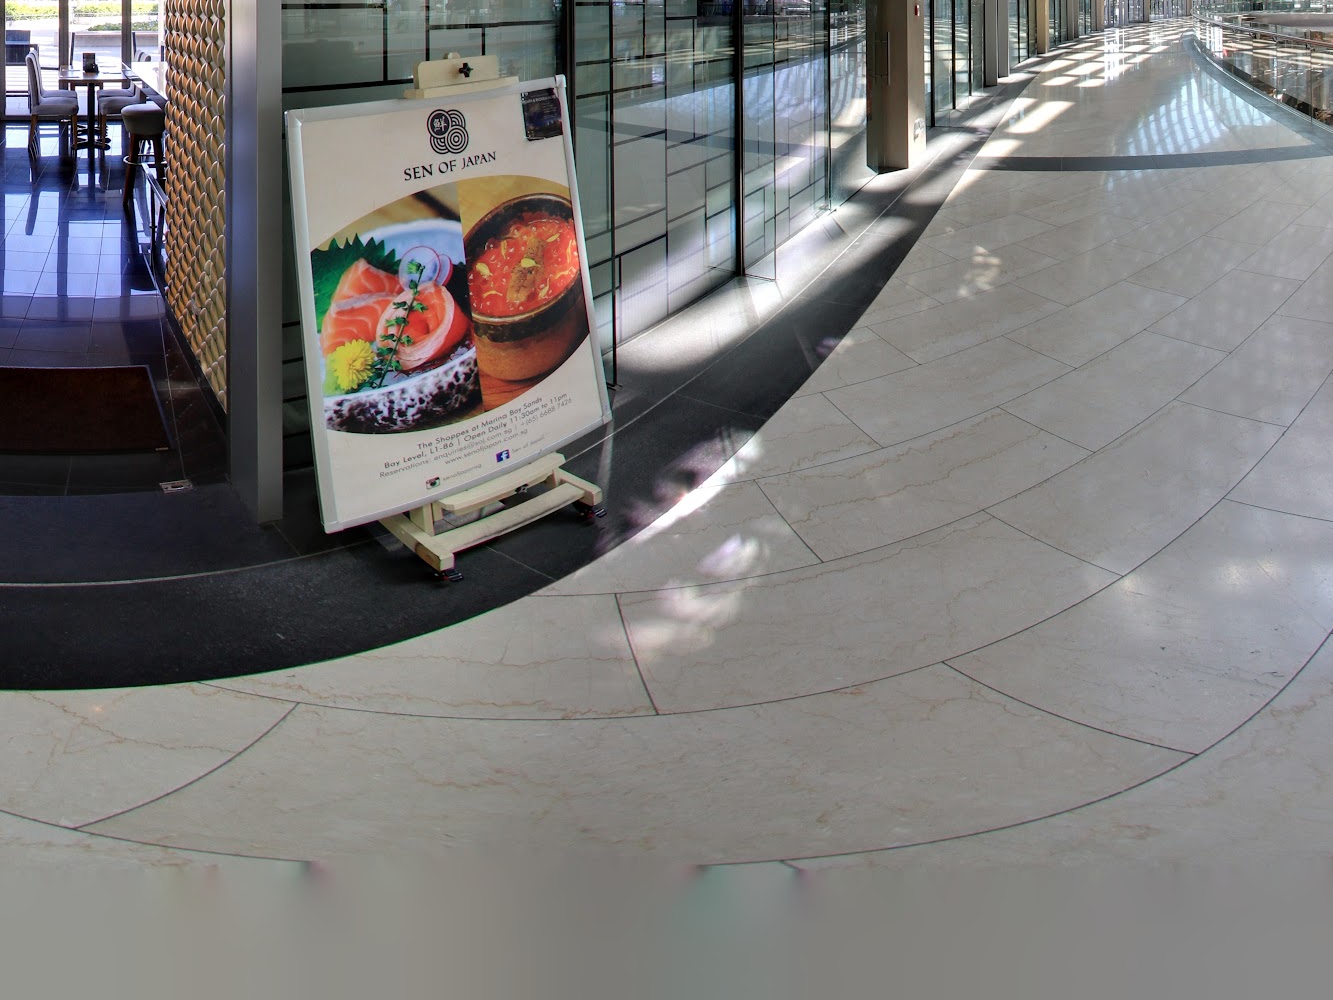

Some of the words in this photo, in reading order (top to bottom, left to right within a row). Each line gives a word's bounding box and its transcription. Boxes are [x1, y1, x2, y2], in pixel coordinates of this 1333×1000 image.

[403, 163, 433, 182] SEN
[438, 159, 457, 174] OF
[461, 151, 497, 170] JAPAN
[384, 460, 400, 469] Bay
[403, 450, 427, 463] Level,
[430, 441, 454, 454] L1-86
[463, 430, 486, 442] Open
[488, 421, 507, 433] Daily
[510, 406, 540, 424] 11:30am
[550, 393, 568, 405] 11pm
[417, 441, 433, 450] The
[435, 429, 469, 444] Shoppes
[471, 424, 479, 432] at
[481, 414, 508, 428] Marina
[509, 406, 522, 416] Bay
[523, 397, 543, 410] Sands
[379, 458, 432, 478] Reservations:
